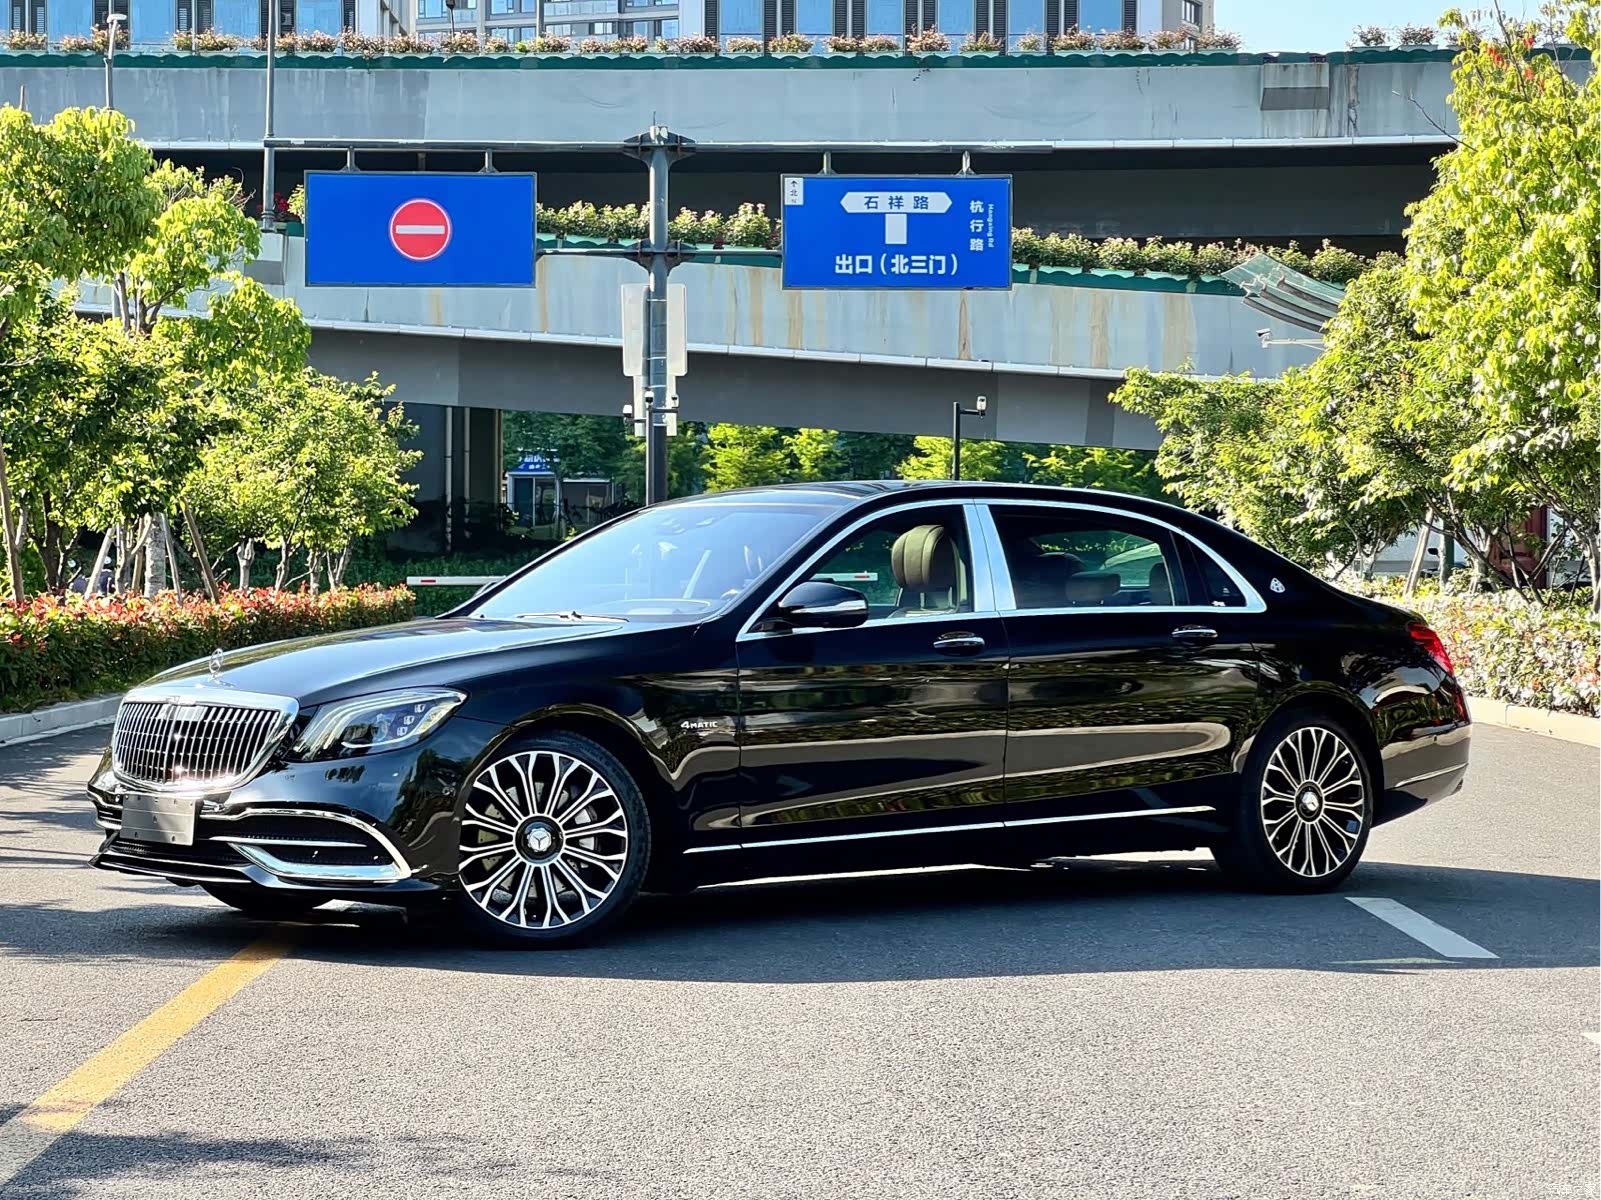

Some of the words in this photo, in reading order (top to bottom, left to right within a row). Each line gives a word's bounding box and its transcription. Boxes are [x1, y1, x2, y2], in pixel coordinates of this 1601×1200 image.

[790, 189, 798, 197] 北
[864, 195, 929, 210] 石祥路
[969, 200, 985, 251] 杭行路
[987, 238, 994, 248] Rd
[680, 720, 718, 729] 4MATIC
